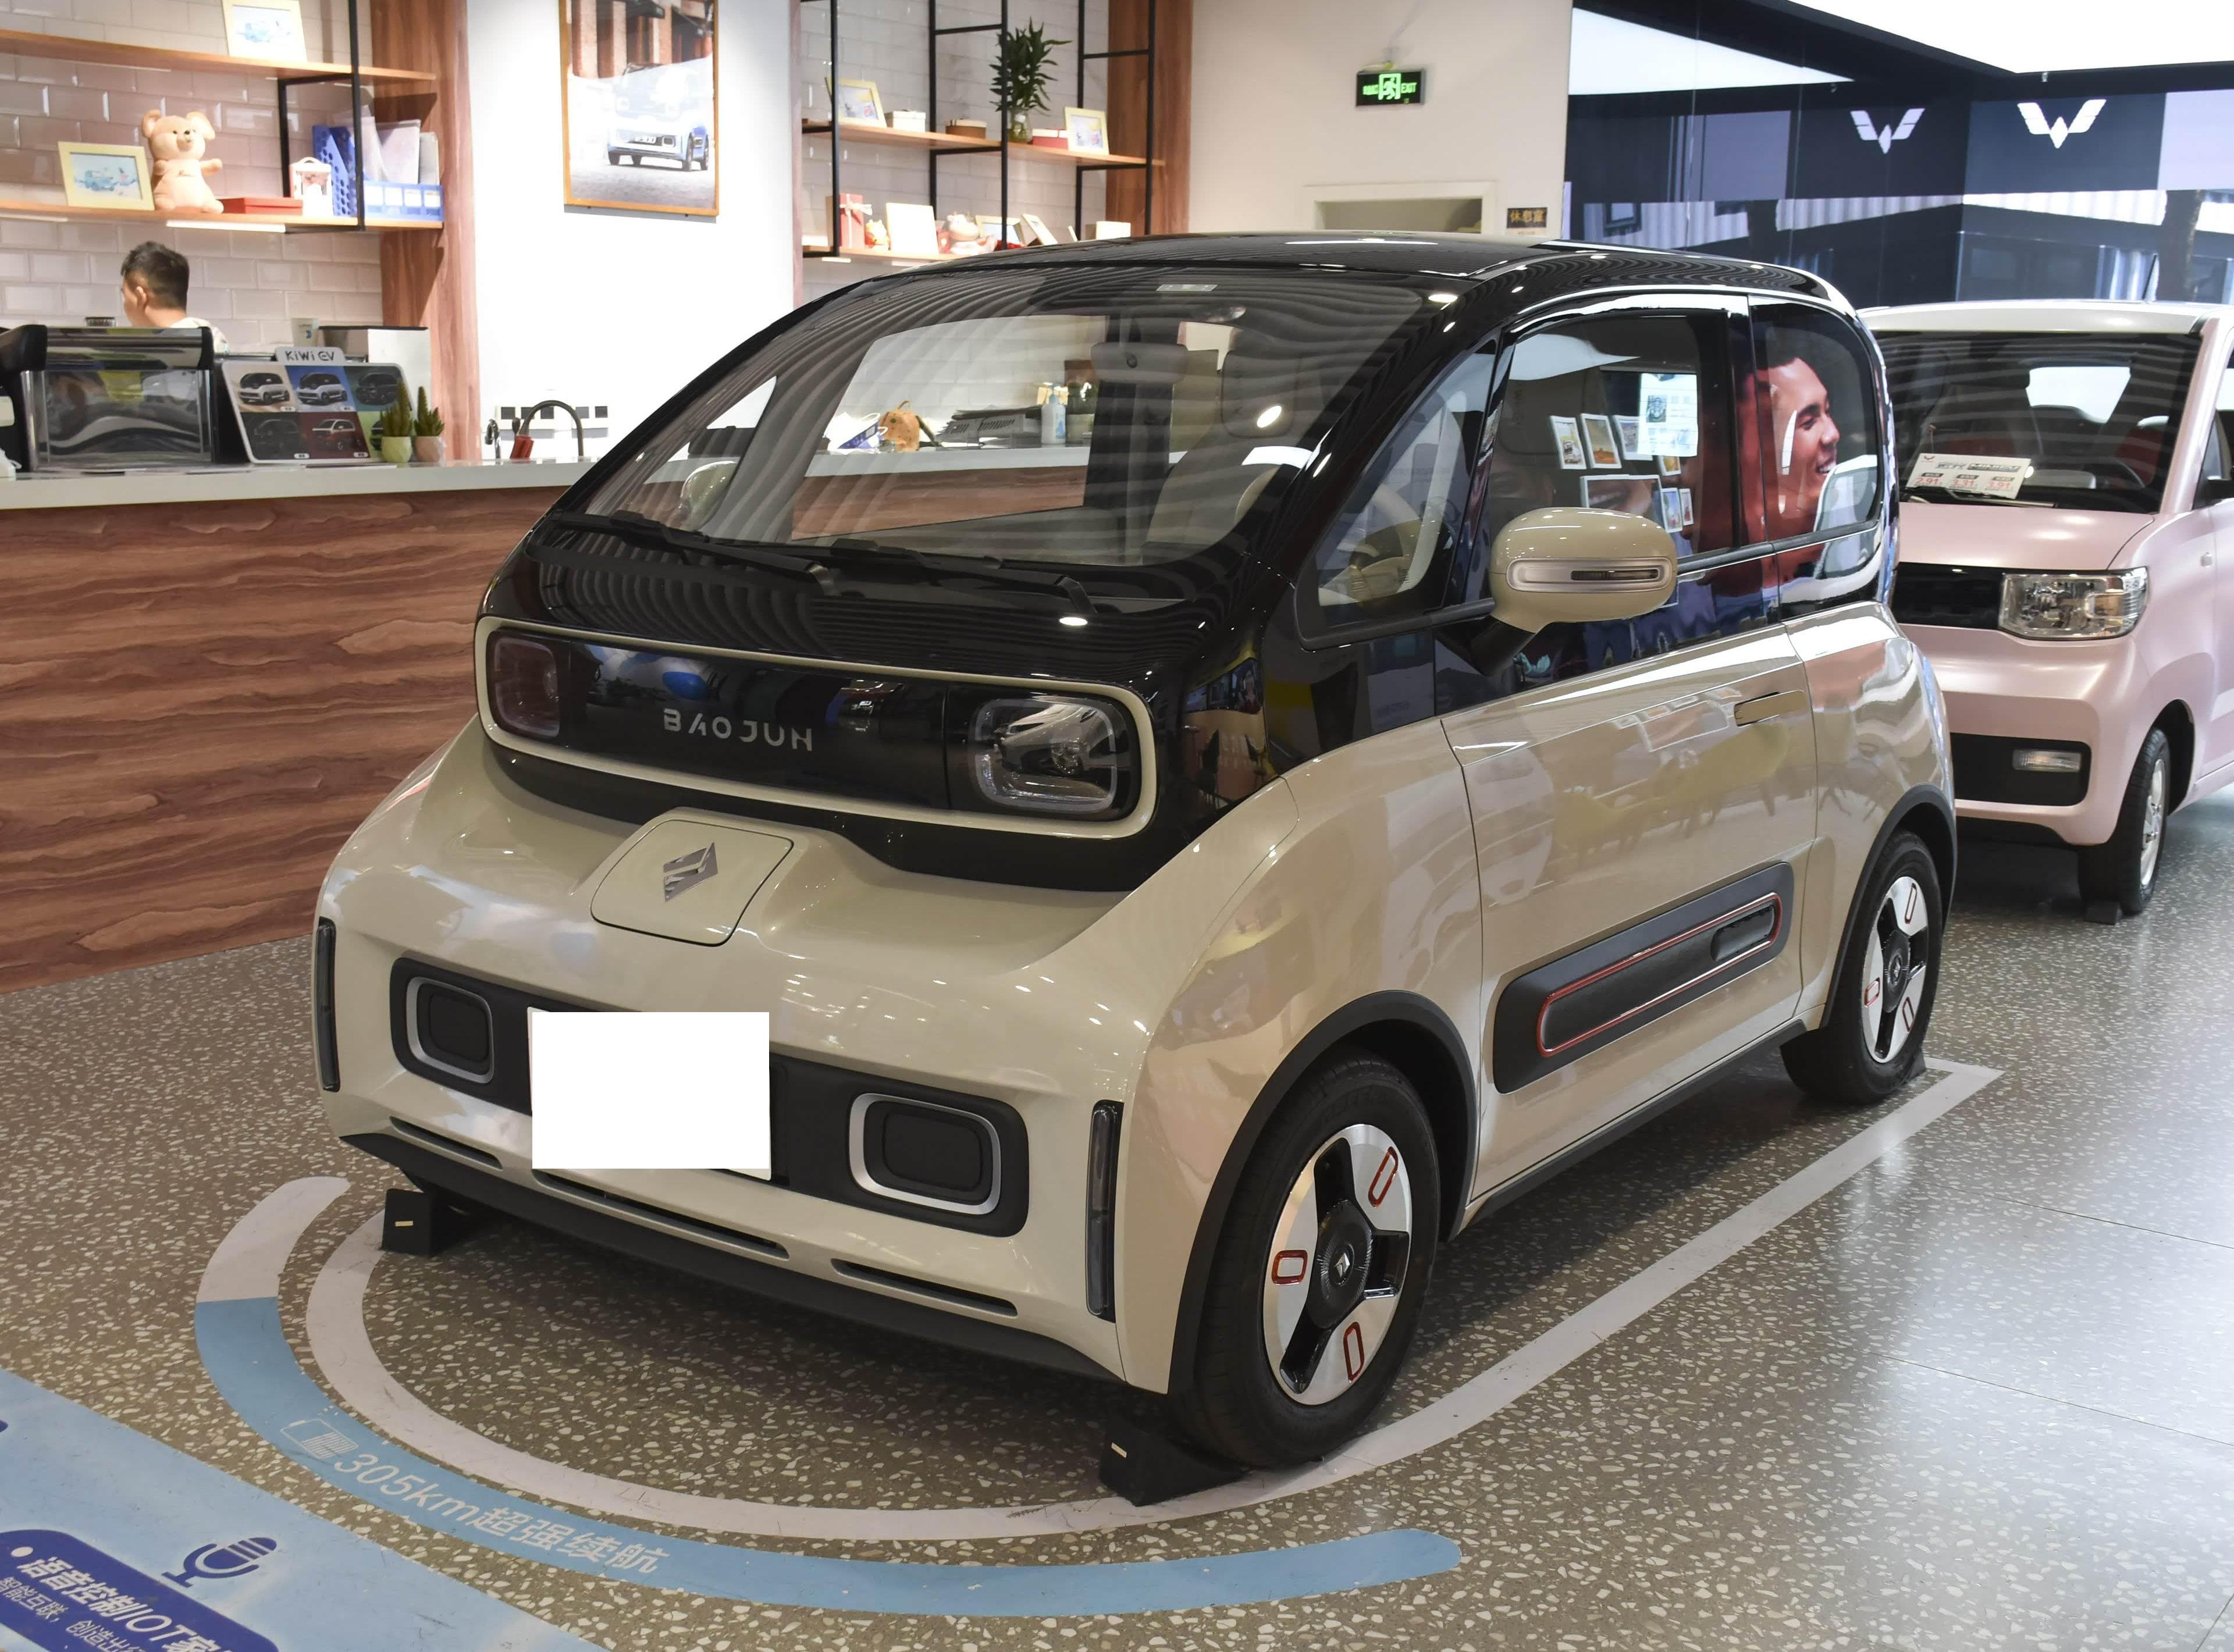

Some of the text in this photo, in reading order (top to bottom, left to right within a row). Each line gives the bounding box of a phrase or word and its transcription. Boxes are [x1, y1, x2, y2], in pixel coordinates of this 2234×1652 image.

[663, 707, 813, 752] BAOJUN
[17, 1557, 234, 1652] 语音控制IOT家
